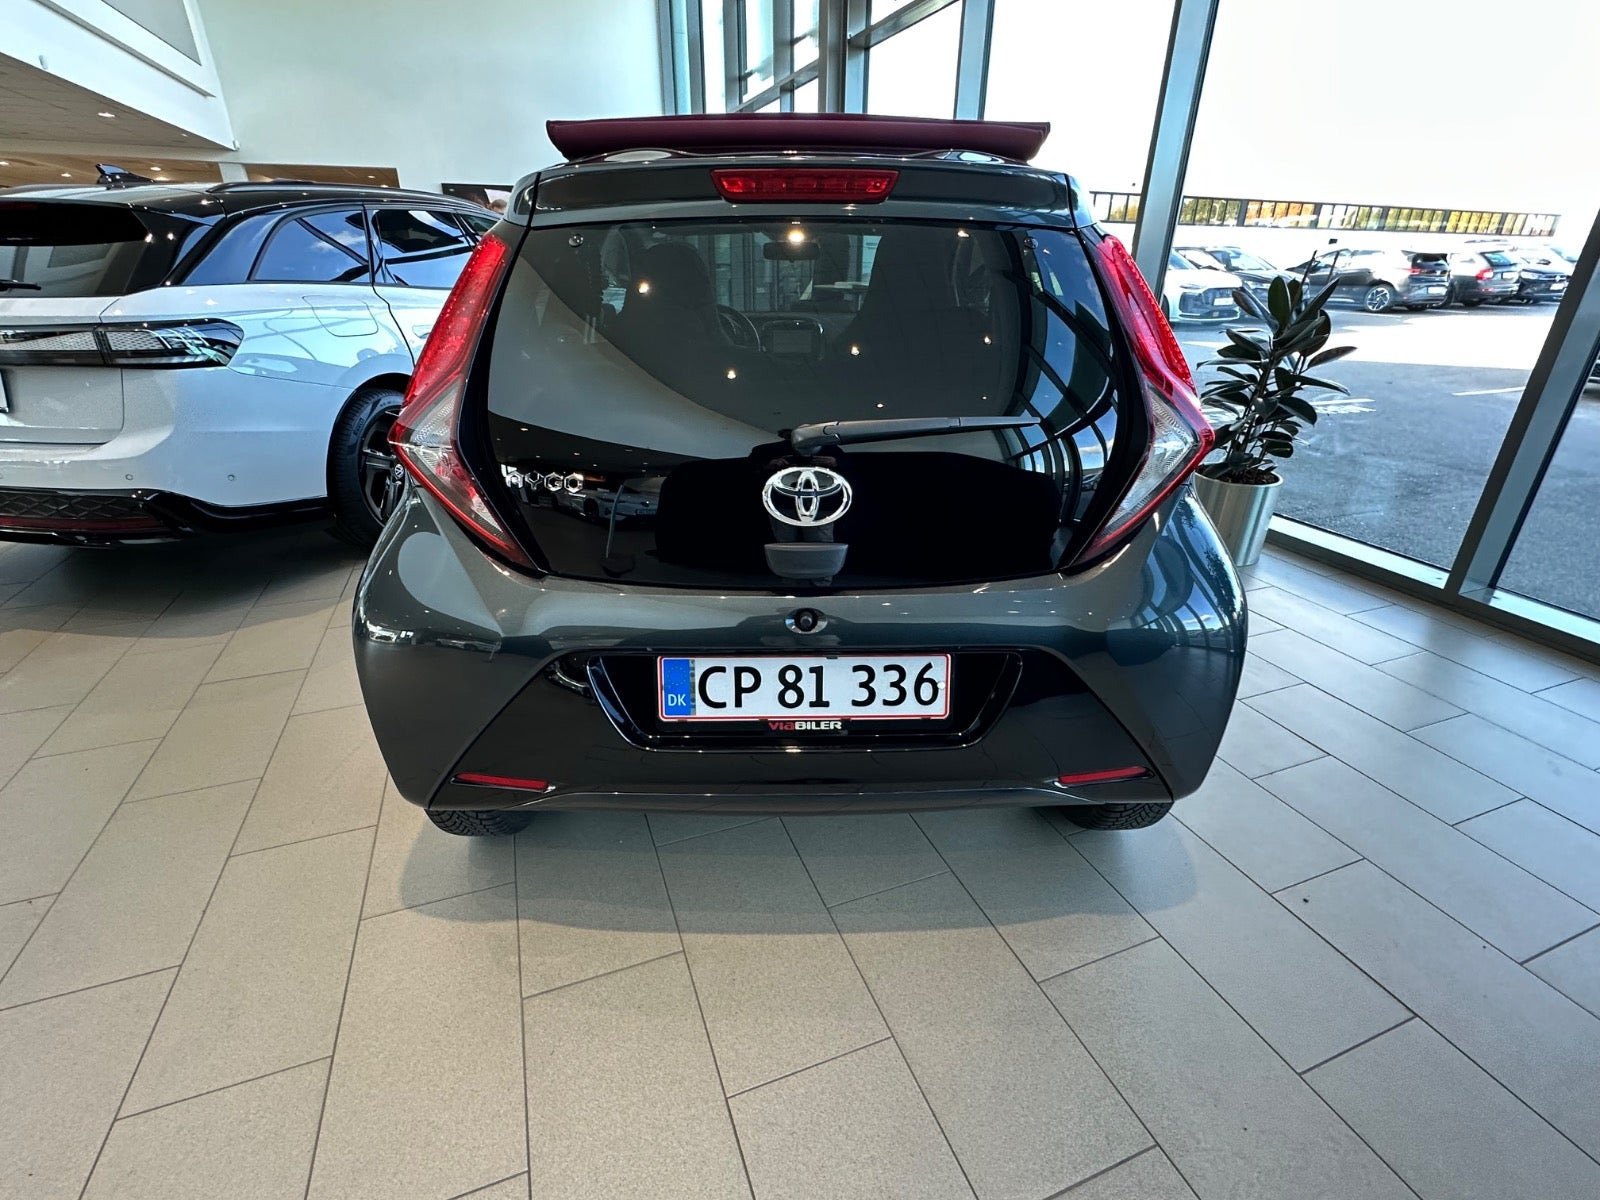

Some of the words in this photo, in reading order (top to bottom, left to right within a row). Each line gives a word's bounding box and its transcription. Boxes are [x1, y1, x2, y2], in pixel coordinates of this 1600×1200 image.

[505, 471, 584, 493] AYGO
[698, 665, 762, 709] CP
[777, 664, 830, 709] 81
[851, 662, 939, 707] 336
[667, 693, 687, 706] DK
